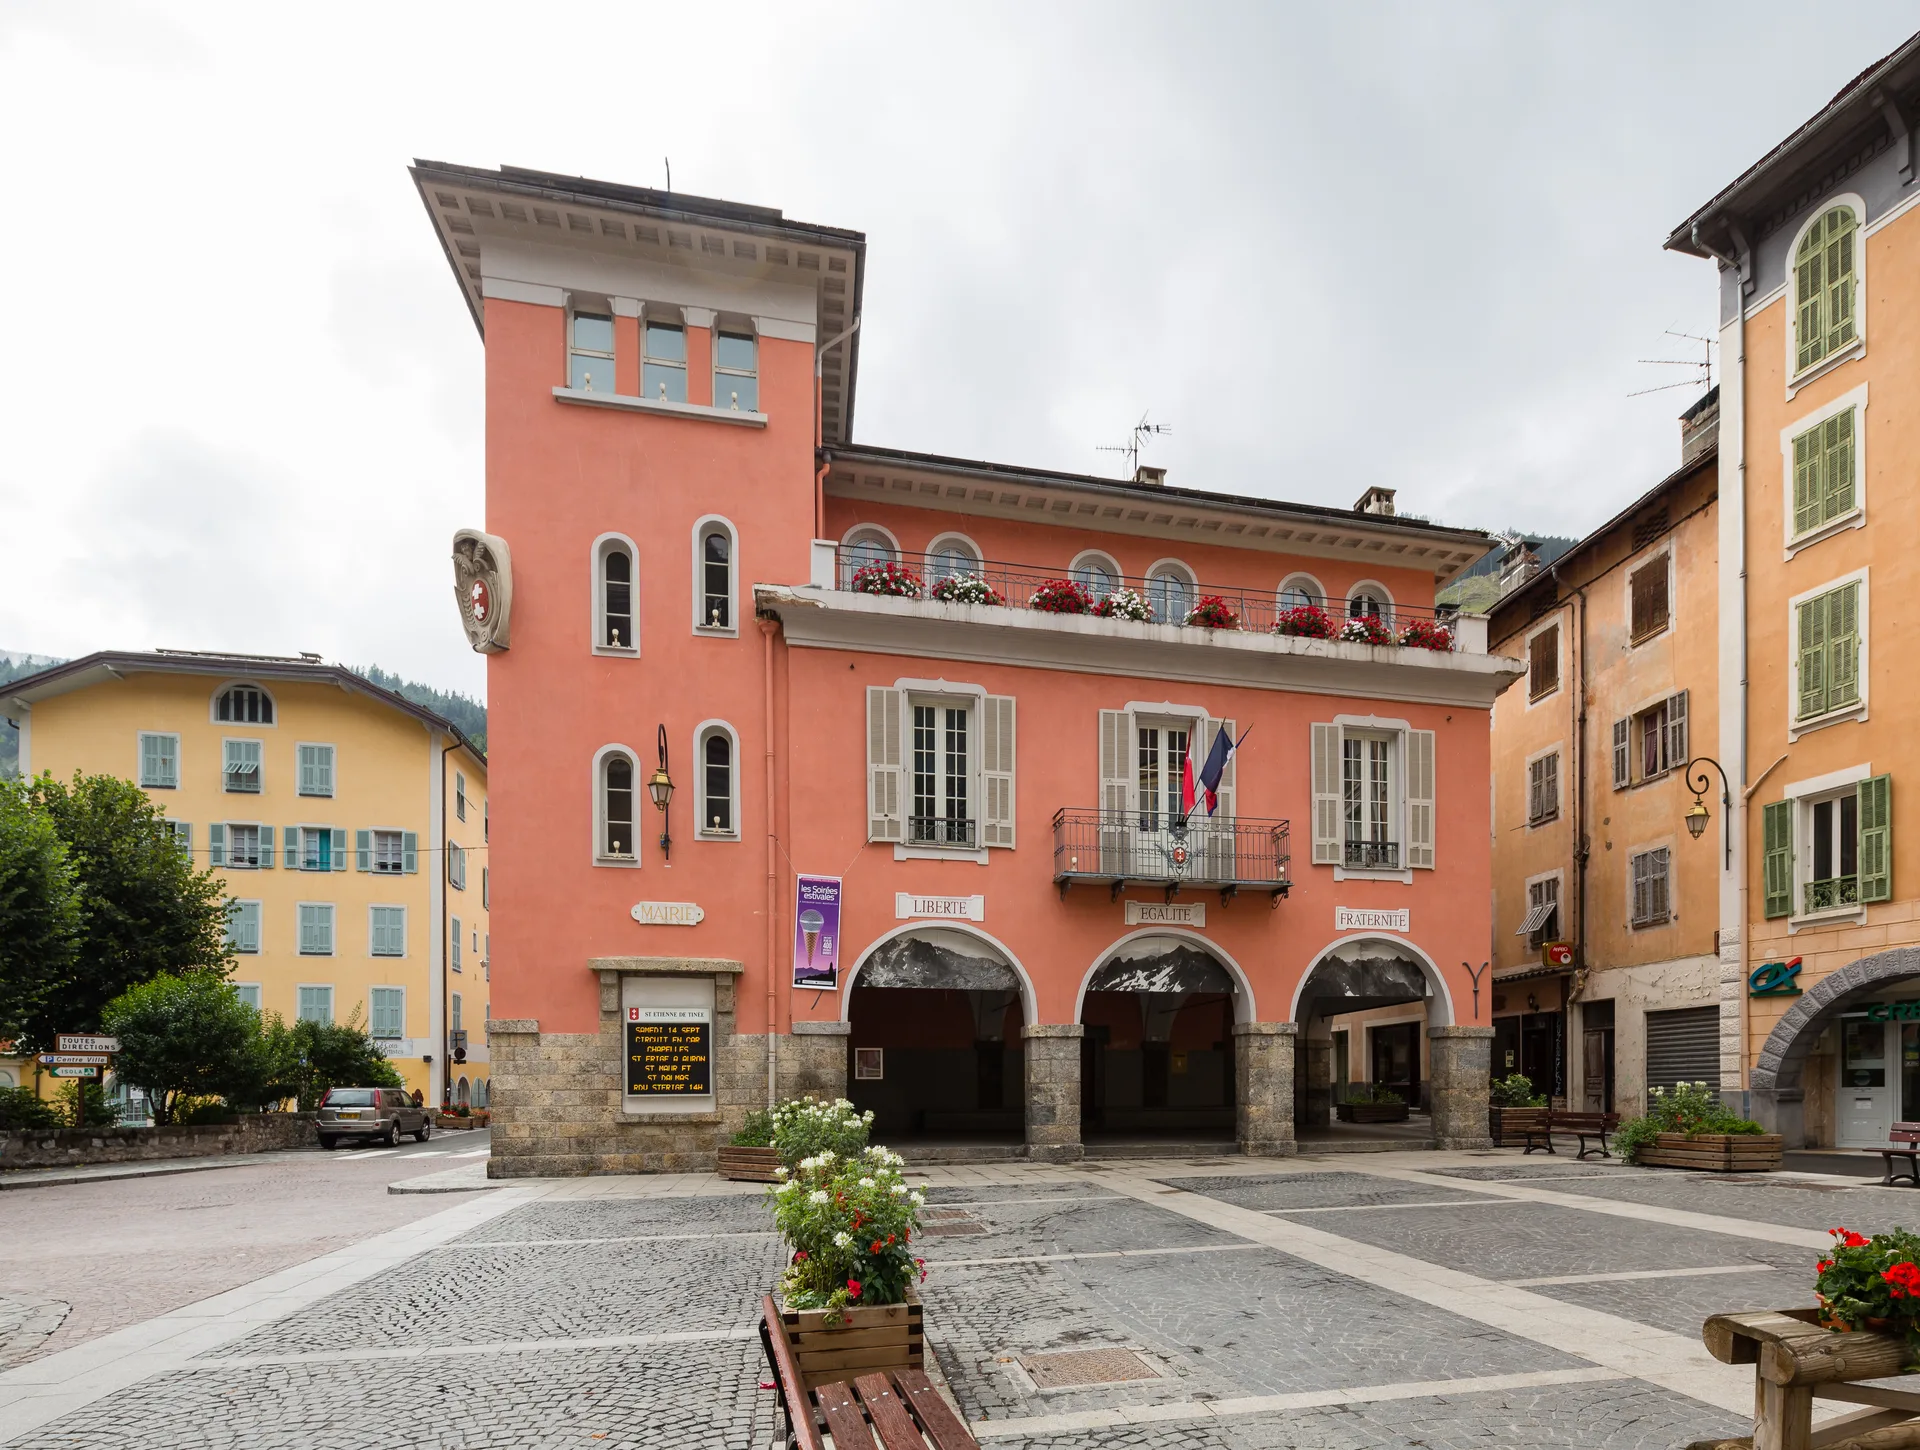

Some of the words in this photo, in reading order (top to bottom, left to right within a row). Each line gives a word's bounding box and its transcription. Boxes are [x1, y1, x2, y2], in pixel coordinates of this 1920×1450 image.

[801, 884, 811, 893] les
[812, 885, 838, 895] Soirées
[804, 892, 835, 901] estivales
[641, 905, 695, 921] MAIRIE
[913, 899, 967, 915] LIBERTE
[1141, 907, 1191, 921] EGALITE
[1340, 912, 1406, 927] FRATERNITE
[635, 1026, 663, 1034] SAMEDI
[668, 1026, 677, 1034] 14
[681, 1026, 700, 1034] SEPT
